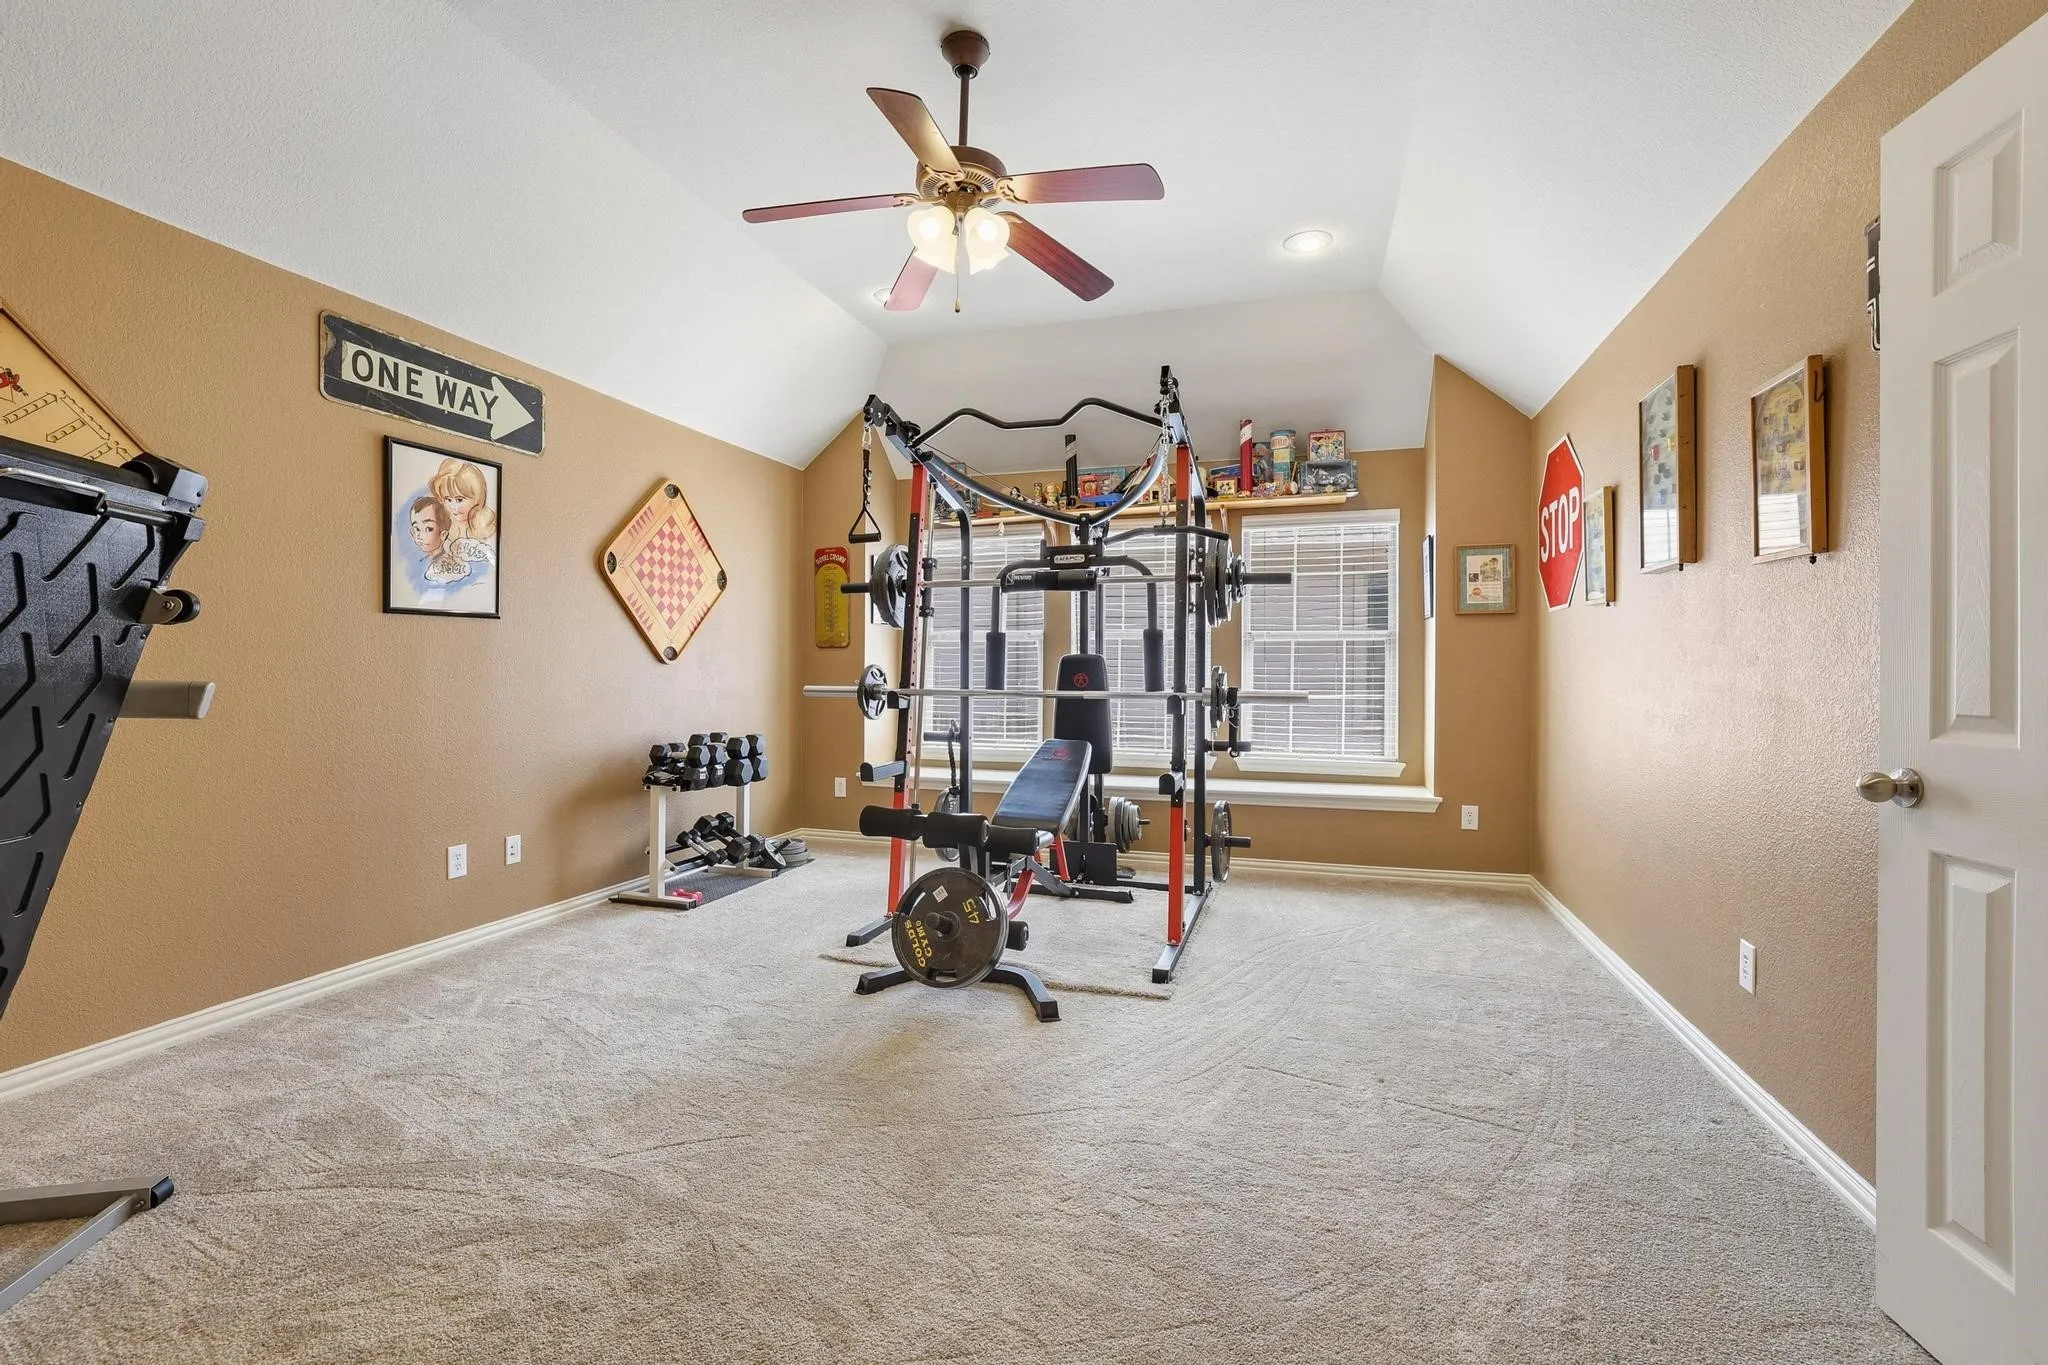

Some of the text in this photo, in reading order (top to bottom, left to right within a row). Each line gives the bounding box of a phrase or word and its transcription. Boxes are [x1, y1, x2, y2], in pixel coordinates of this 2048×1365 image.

[352, 349, 499, 420] ONE WAY
[1541, 486, 1580, 563] STOP
[962, 898, 980, 924] 45
